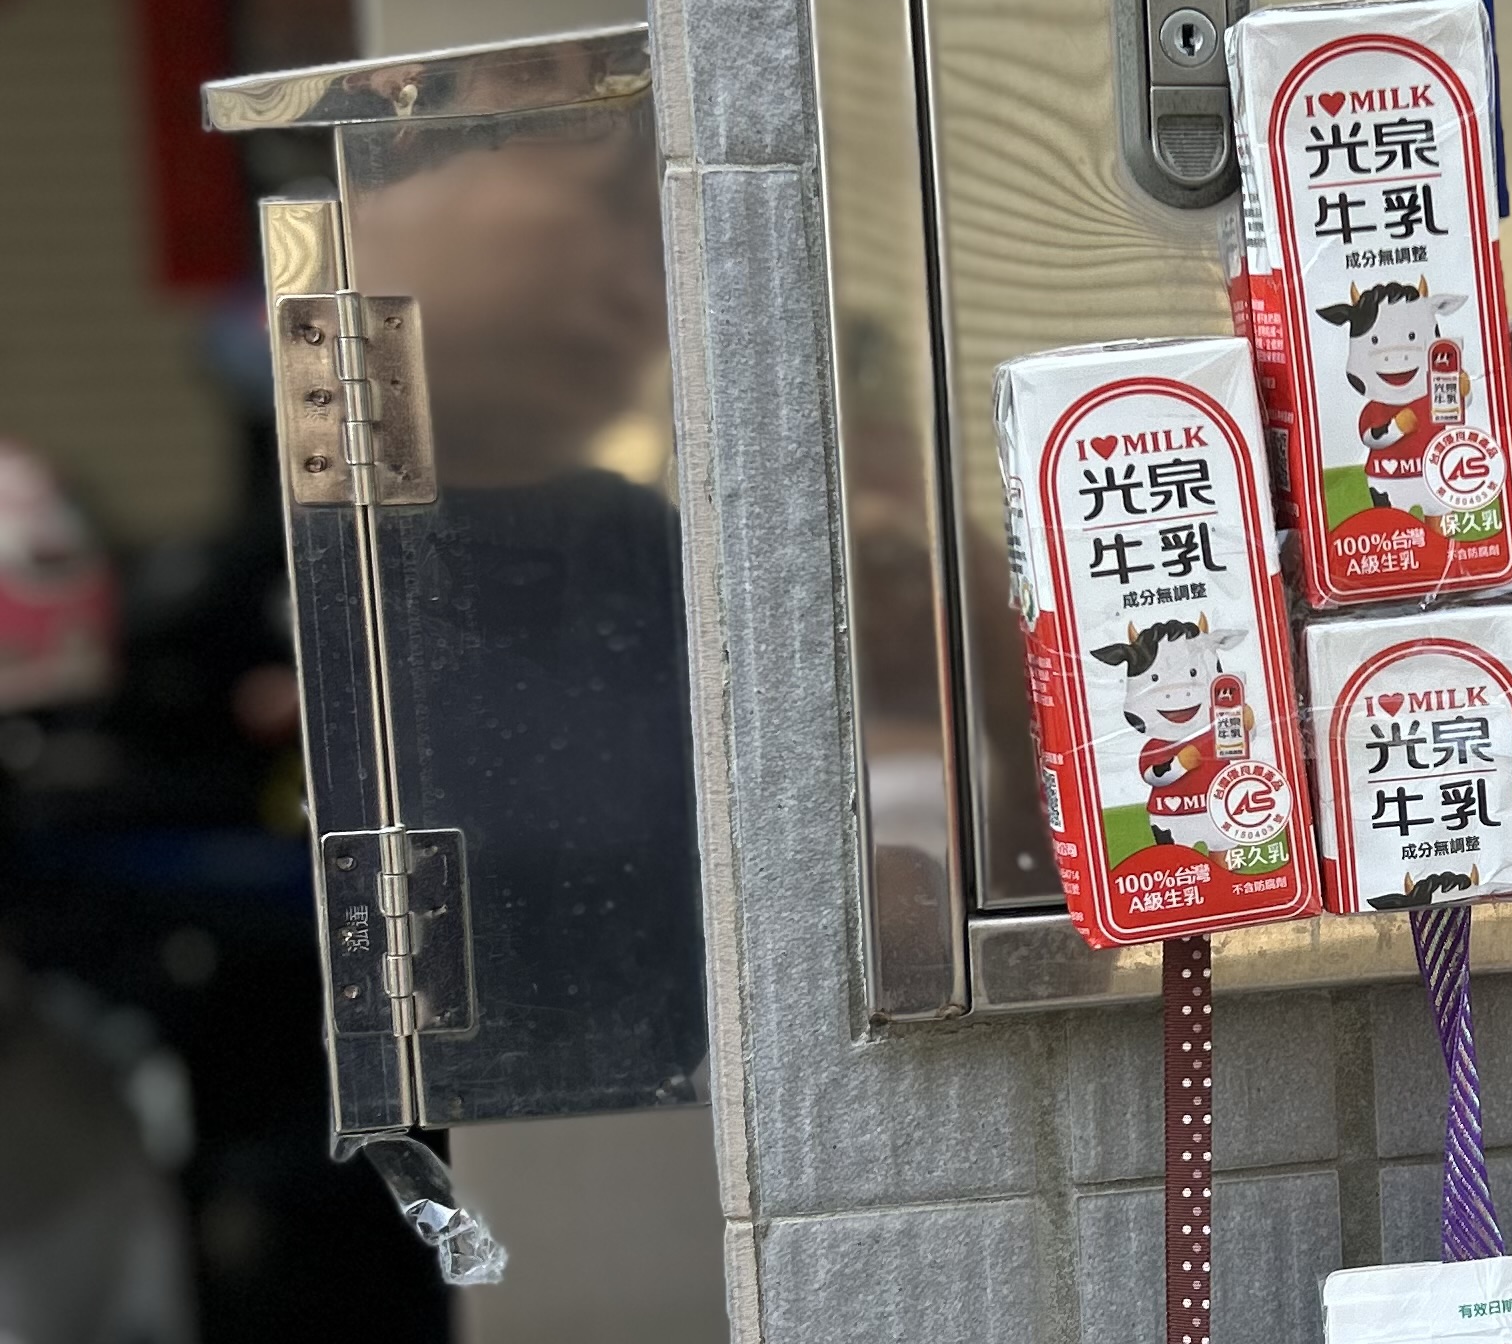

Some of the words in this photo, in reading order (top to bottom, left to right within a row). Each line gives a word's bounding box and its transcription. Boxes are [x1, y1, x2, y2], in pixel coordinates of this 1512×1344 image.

[1350, 84, 1434, 113] MILK
[1305, 118, 1440, 179] 光泉
[1315, 184, 1448, 244] 牛乳
[1123, 425, 1208, 456] MILK
[1079, 458, 1215, 521] 光泉
[1440, 512, 1502, 536] 保久乳
[1090, 522, 1226, 584] 牛乳
[1334, 527, 1425, 557] 100%台灣
[1346, 553, 1420, 576] A級生乳
[1408, 686, 1490, 714] MILK
[1366, 715, 1495, 774] 光泉
[1372, 778, 1501, 836] 牛乳
[1225, 842, 1289, 870] 保久乳
[1115, 863, 1211, 894] 100%台灣
[1129, 889, 1204, 913] A級生乳
